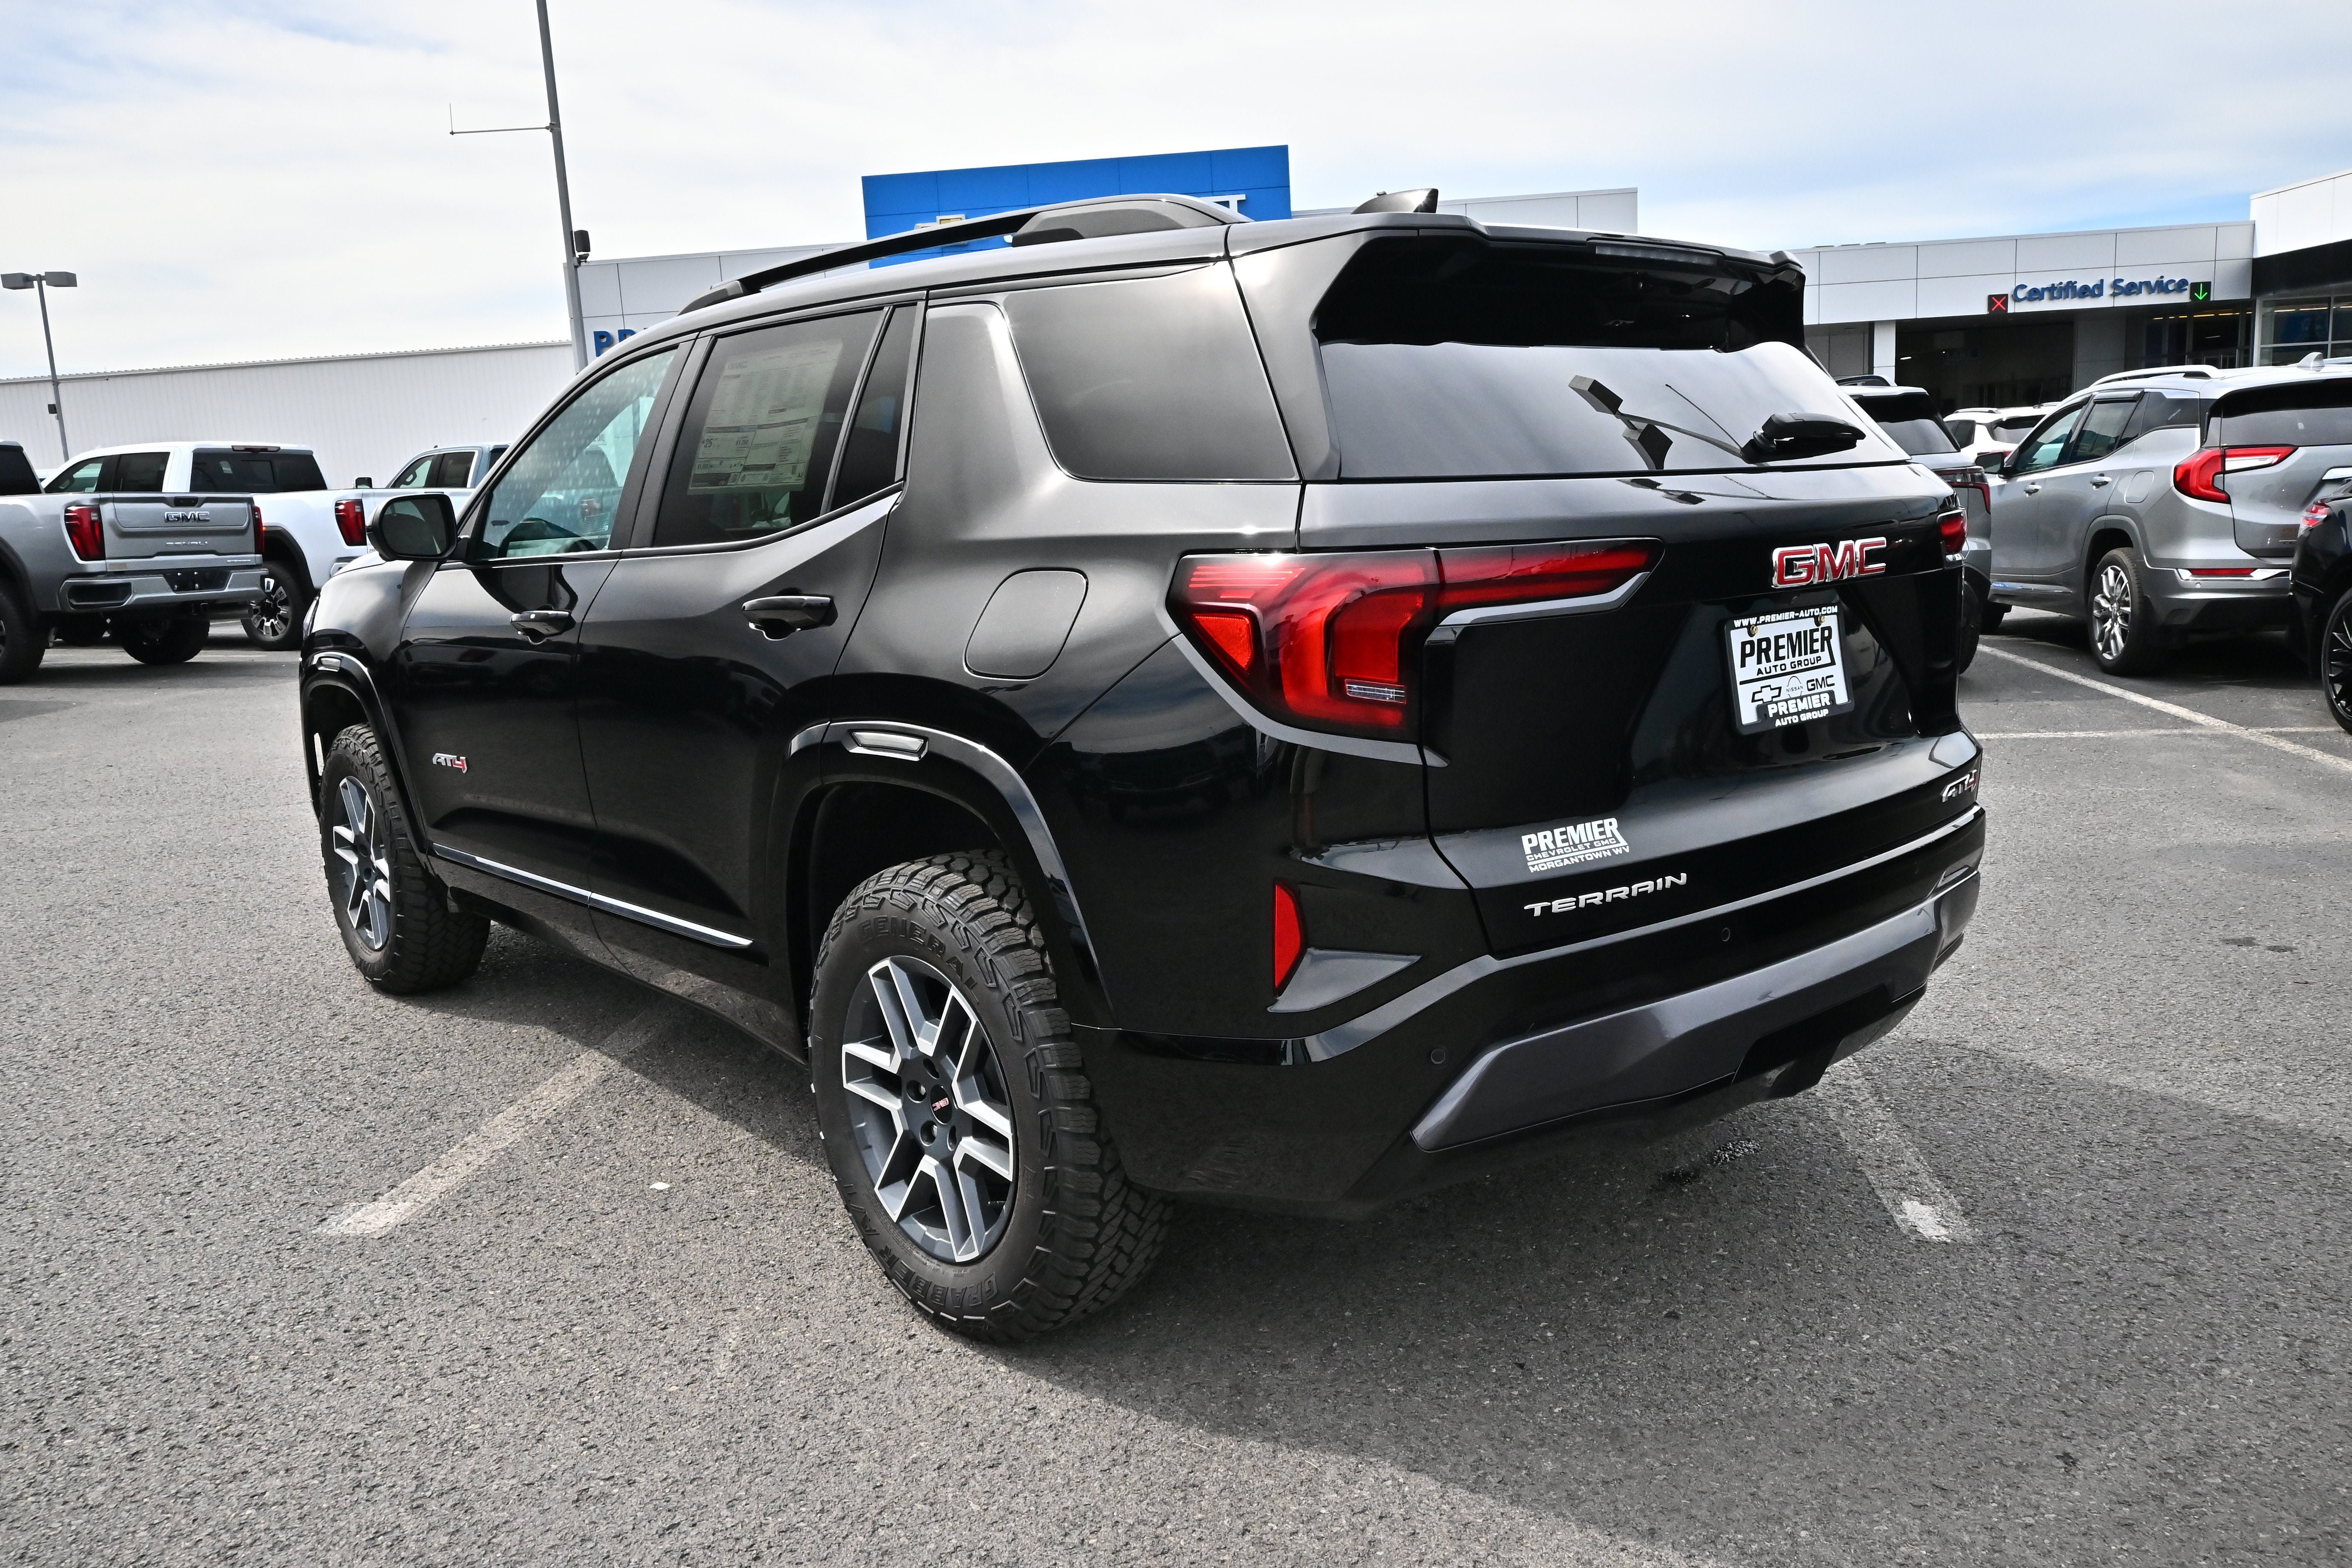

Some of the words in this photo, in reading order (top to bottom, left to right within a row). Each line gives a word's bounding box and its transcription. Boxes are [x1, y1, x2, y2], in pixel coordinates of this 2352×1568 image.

[2012, 279, 2104, 302] Certified
[2111, 275, 2189, 296] Service
[164, 512, 210, 523] GMC
[1771, 537, 1886, 589] GMC
[1734, 605, 1838, 628] WWW.PREMIER-AUTO.COM
[1740, 626, 1834, 668] PREMIER
[1756, 664, 1786, 676] AUTO
[1790, 656, 1821, 669] GROUP
[1806, 675, 1835, 691] GMC
[1767, 693, 1830, 717] PREMIER
[1775, 715, 1798, 727] AUTO
[1800, 709, 1829, 721] GROUP
[433, 753, 467, 773] AT4
[1941, 769, 1977, 803] AT4
[1522, 817, 1622, 855] PREMIER
[1526, 841, 1591, 861] CHEVROLET
[1593, 838, 1617, 847] GMC
[1529, 849, 1612, 873] MORGANTOWN
[1612, 845, 1629, 855] WV
[1524, 873, 1687, 917] TERRAIN
[858, 915, 980, 1005] GENERAL
[879, 1245, 999, 1308] GRABBER
